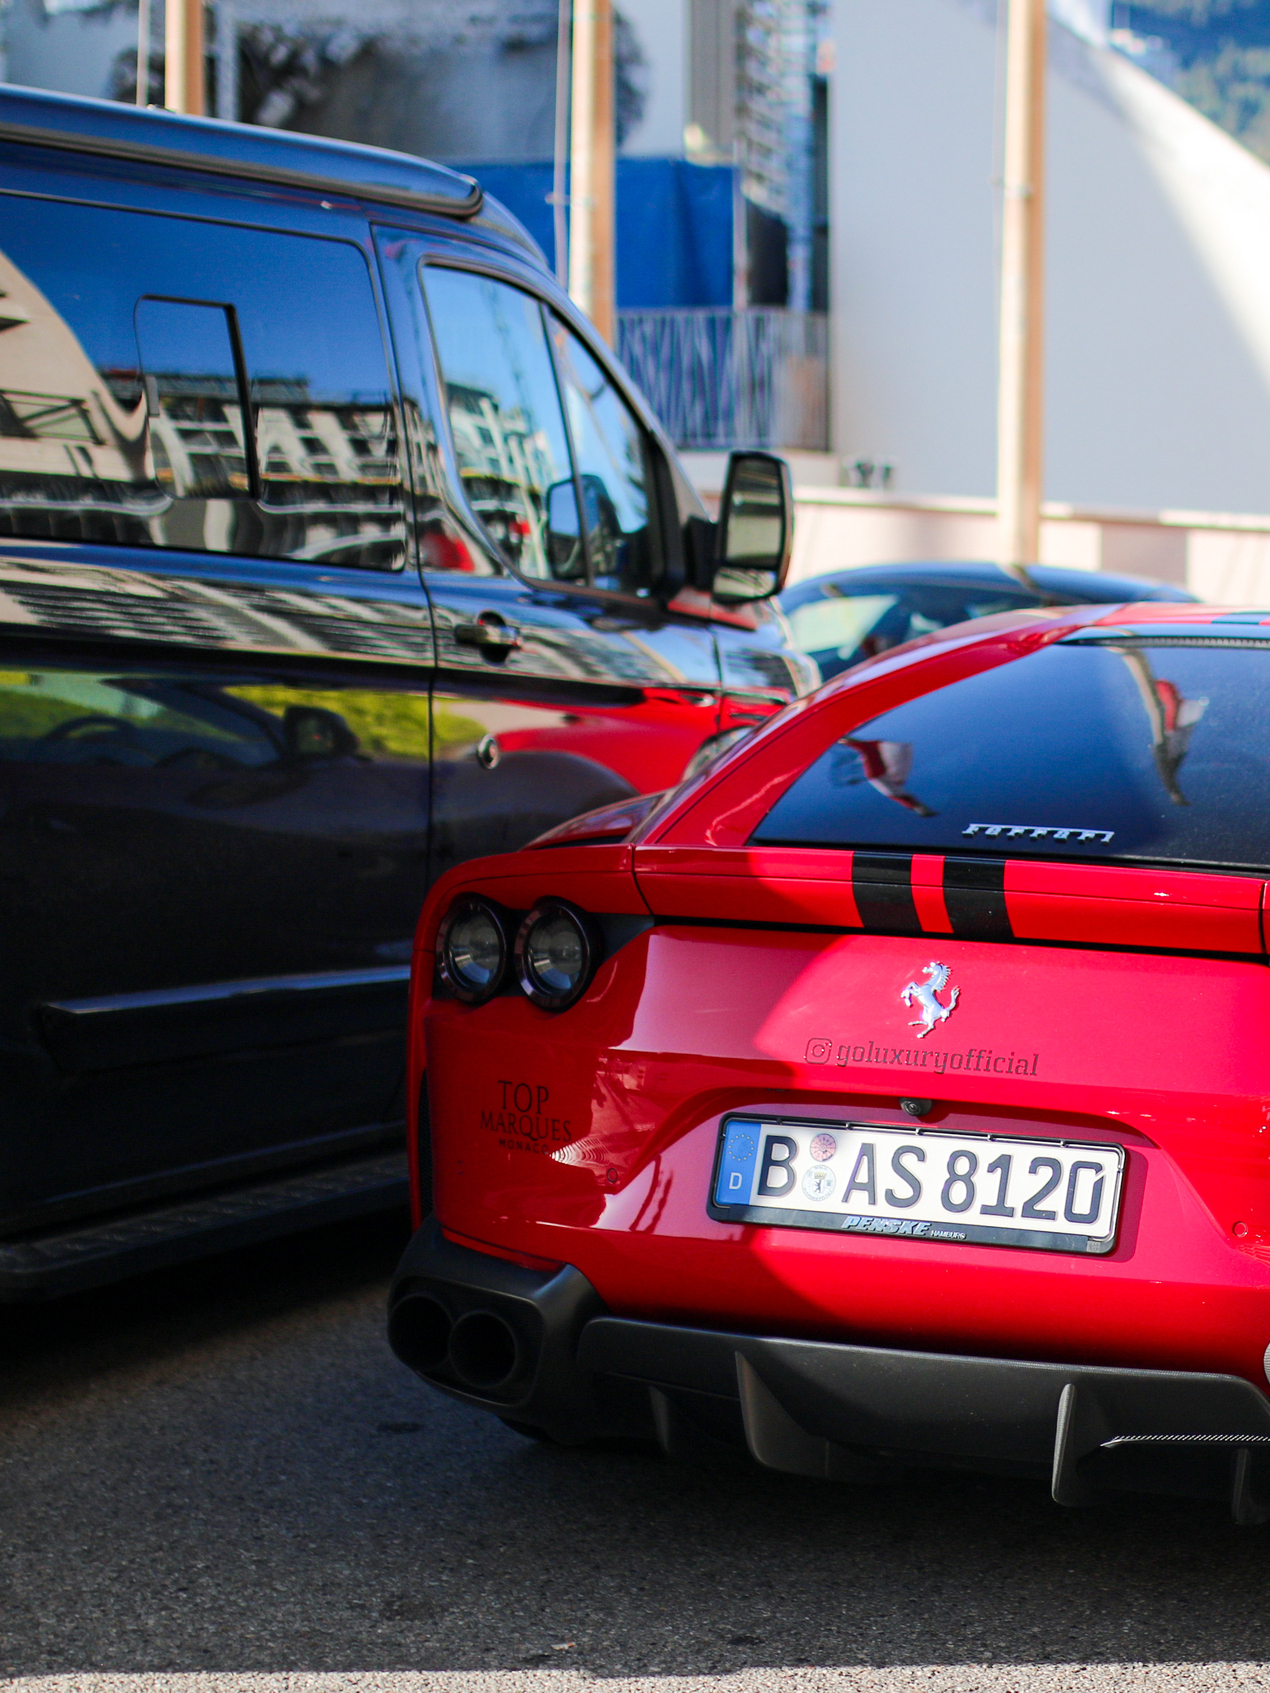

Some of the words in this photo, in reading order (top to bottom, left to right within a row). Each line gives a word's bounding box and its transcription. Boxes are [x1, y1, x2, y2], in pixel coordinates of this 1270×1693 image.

[836, 1041, 1039, 1076] goluxuryofficial
[498, 1080, 549, 1115] TOP
[480, 1108, 572, 1143] MARQUES
[499, 1138, 550, 1155] MONACO
[756, 1134, 799, 1197] B
[841, 1142, 926, 1209] AS
[940, 1149, 1103, 1225] 8120
[840, 1214, 933, 1237] PENSKE
